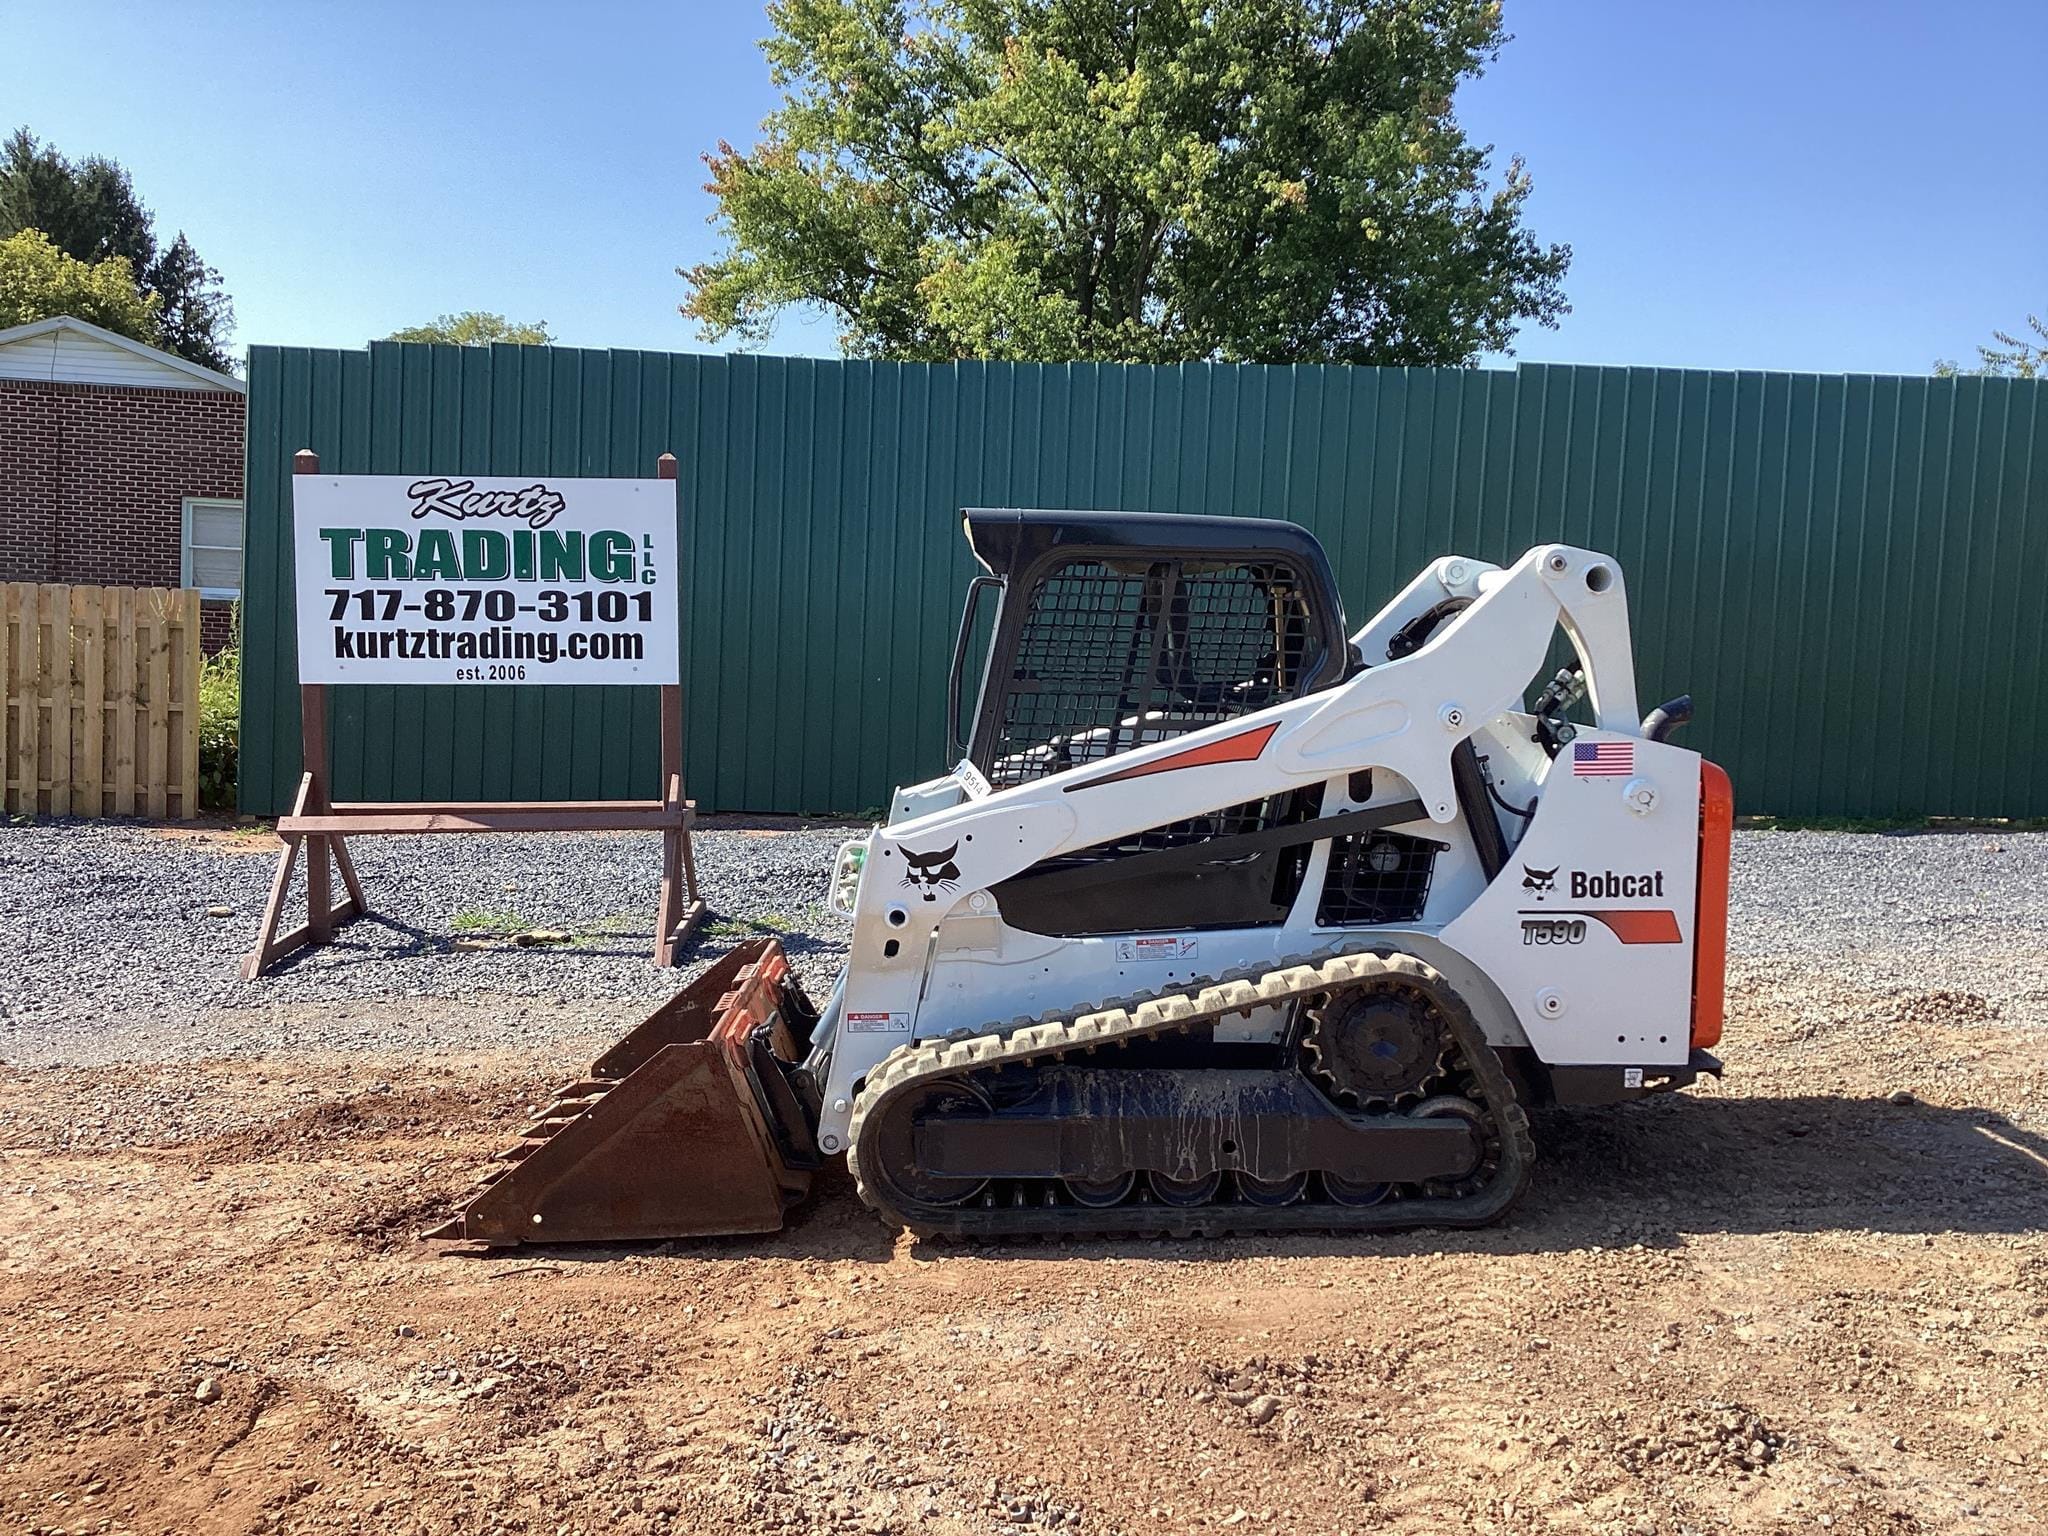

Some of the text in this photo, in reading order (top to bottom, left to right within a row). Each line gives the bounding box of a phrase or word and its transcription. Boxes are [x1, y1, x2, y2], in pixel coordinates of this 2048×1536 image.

[407, 478, 566, 529] Kurtz
[319, 528, 636, 584] TRADING
[641, 533, 656, 585] LLC
[324, 589, 653, 622] 717-870-3101
[334, 626, 644, 663] kurtztrading.com
[456, 665, 526, 681] est. 2006
[963, 771, 983, 795] 9514
[1570, 870, 1664, 899] Bobcat
[1521, 920, 1587, 945] T590
